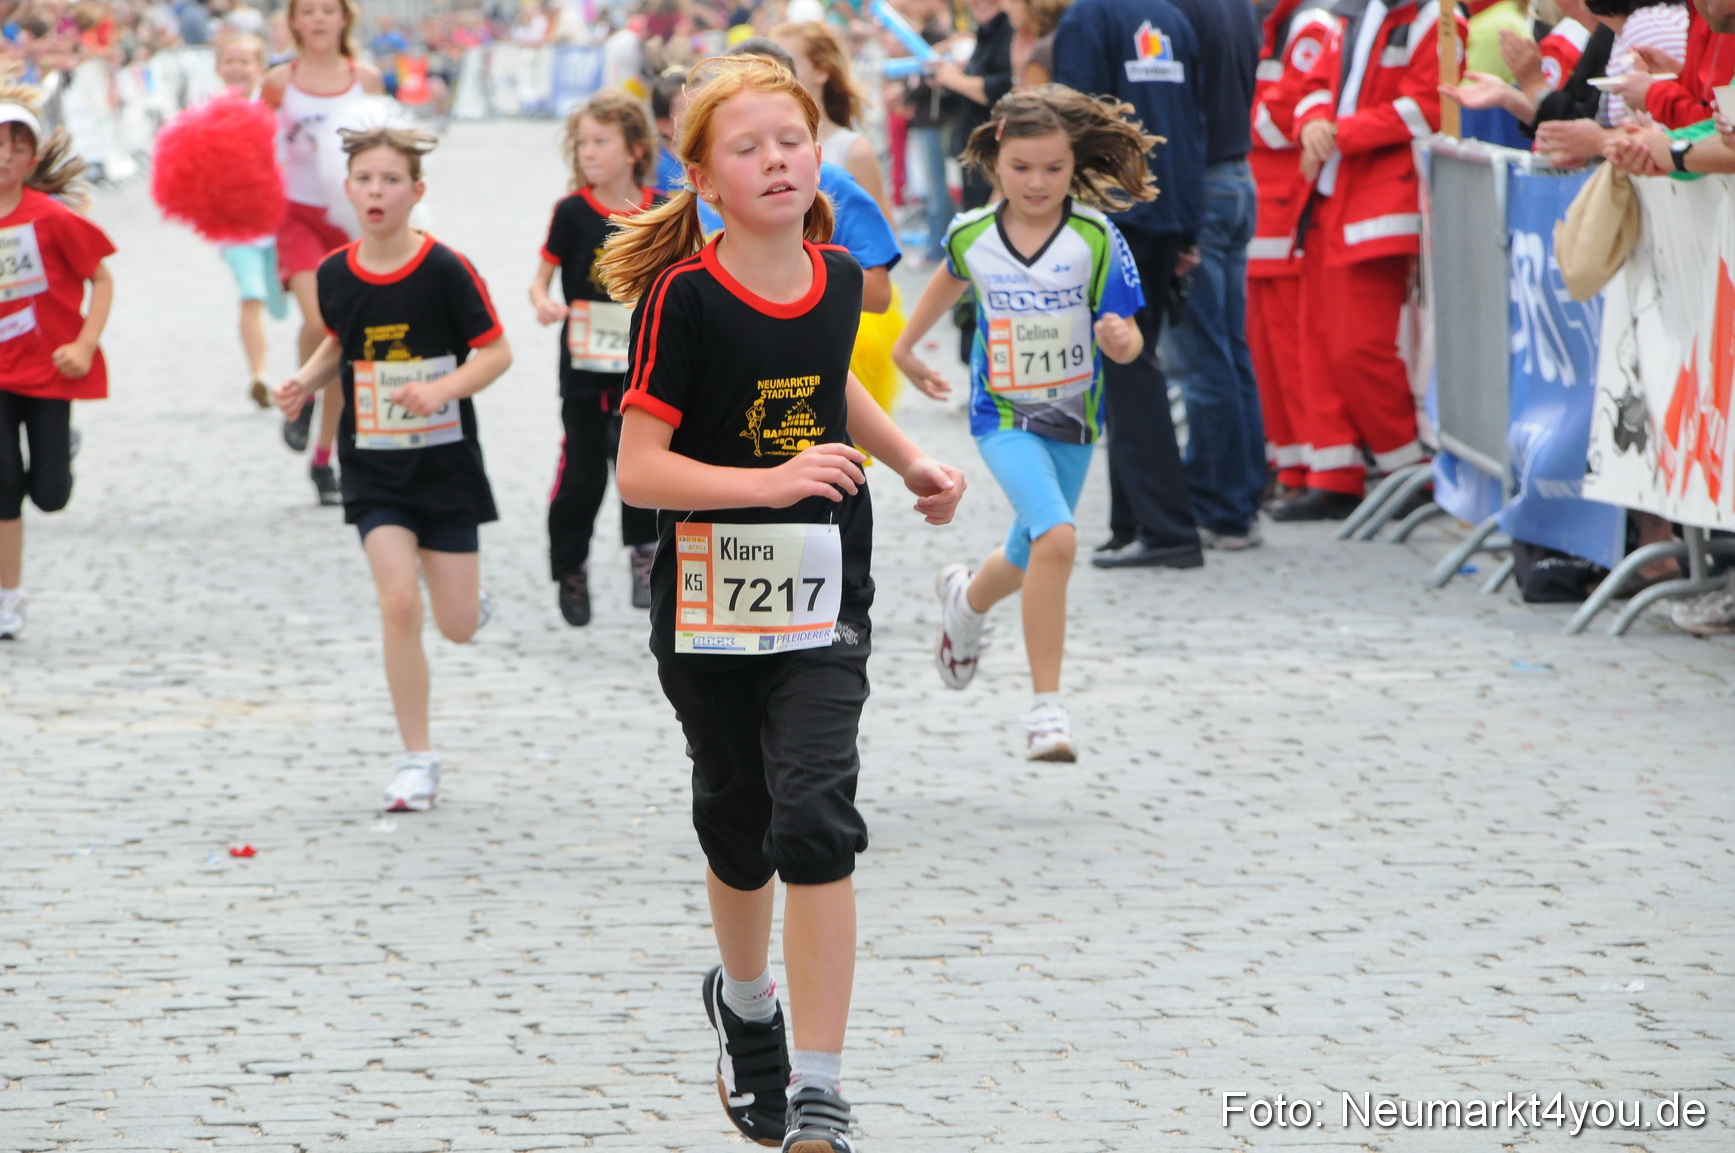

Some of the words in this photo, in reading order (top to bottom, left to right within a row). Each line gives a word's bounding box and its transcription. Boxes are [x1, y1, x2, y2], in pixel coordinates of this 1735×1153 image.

[988, 285, 1083, 311] BOCK
[1016, 325, 1059, 342] Celina
[1020, 344, 1084, 375] 7119
[757, 375, 821, 390] NEUMARKTER
[760, 386, 815, 400] STADTLAUF
[720, 537, 774, 560] Klara
[723, 577, 826, 612] 7217
[693, 636, 735, 647] BOCK
[776, 629, 831, 645] PFLEIDERER
